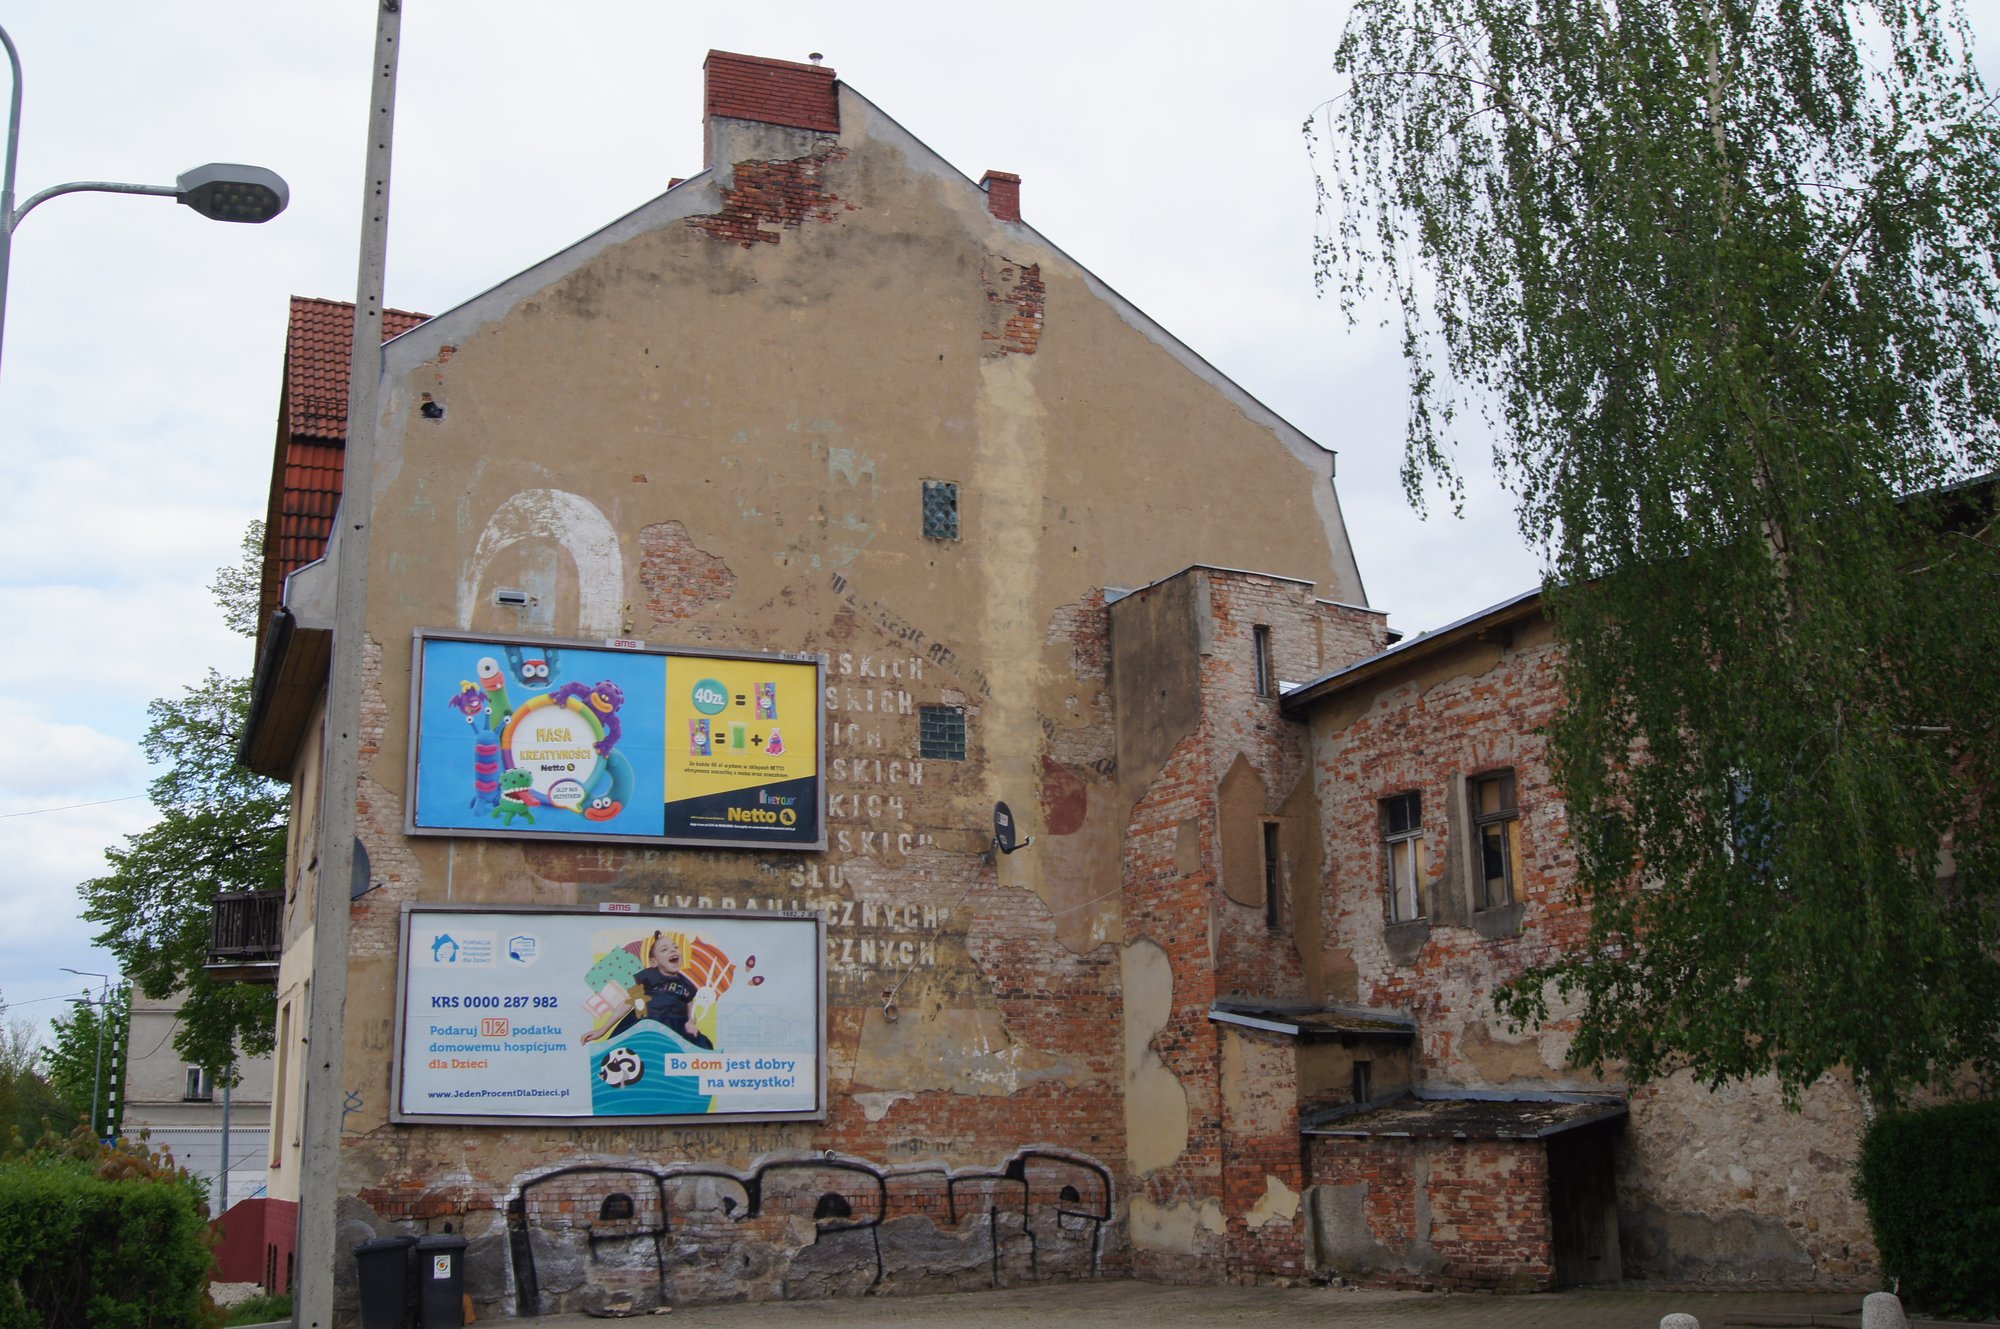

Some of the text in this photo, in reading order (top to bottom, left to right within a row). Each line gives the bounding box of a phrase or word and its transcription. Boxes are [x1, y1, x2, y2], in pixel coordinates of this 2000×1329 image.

[614, 640, 636, 648] ams
[536, 727, 572, 742] MASA
[519, 748, 592, 761] KREATYWNOŚCI
[541, 764, 566, 772] Netto
[727, 807, 777, 823] Netto
[608, 903, 632, 911] ams
[431, 996, 558, 1008] KRS 0000 287 982
[429, 1021, 562, 1038] Podaruj 1% podatku
[429, 1041, 567, 1054] domowemu hospicjum
[428, 1058, 488, 1069] dla Dzieci
[671, 1058, 796, 1072] Bo dom jest dobry
[707, 1076, 795, 1090] na wszystko!
[427, 1088, 570, 1099] www.JedenProcentDlaDzieci.pl
